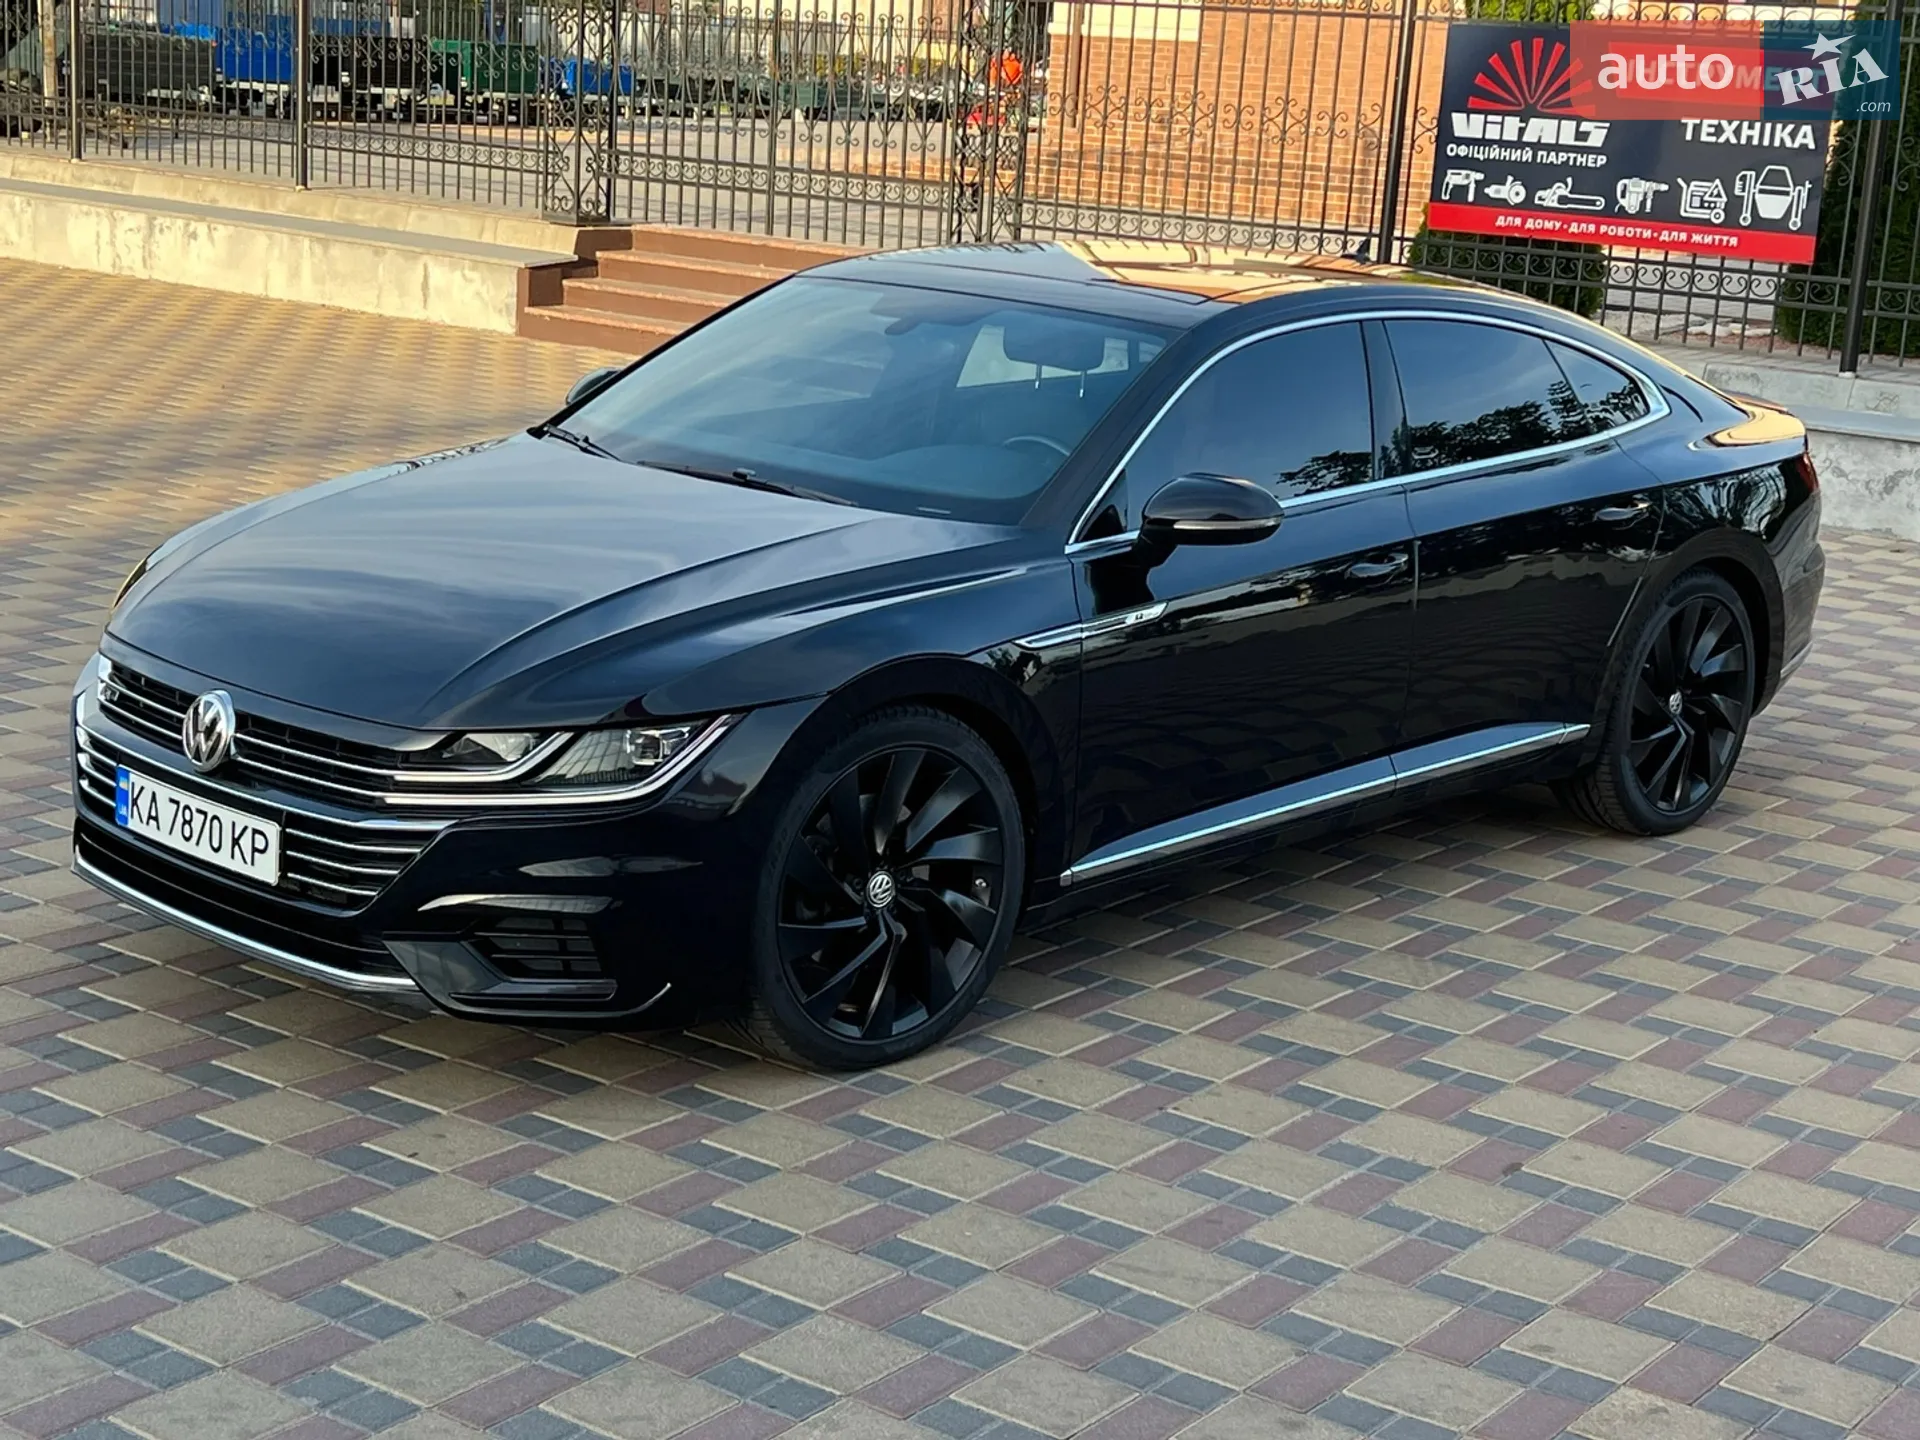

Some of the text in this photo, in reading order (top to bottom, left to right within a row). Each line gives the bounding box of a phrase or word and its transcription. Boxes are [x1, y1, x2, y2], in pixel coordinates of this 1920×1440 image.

[1680, 117, 1816, 150] ТЕХНІКА
[1446, 143, 1608, 168] ОФІЦІЙНИЙ ПАРТНЕР
[1495, 215, 1739, 247] ДЛЯ ДОМУ ДЛЯ РОБОТИ ДЛЯ ЖИТТЯ
[130, 781, 269, 867] KA 7870 KP
